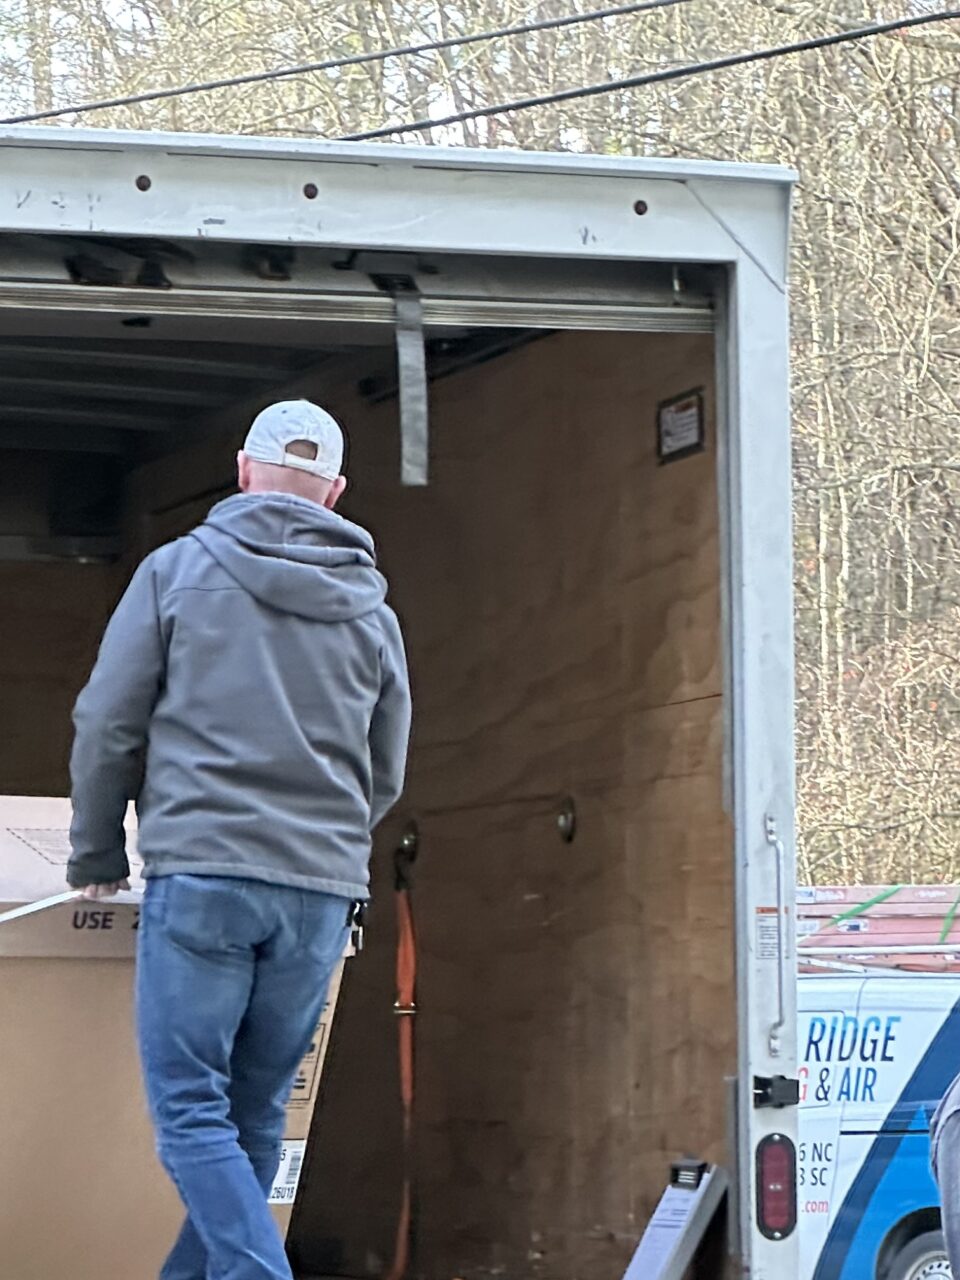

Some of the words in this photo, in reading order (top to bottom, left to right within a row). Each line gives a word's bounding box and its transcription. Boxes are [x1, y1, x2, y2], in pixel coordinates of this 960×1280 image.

[72, 911, 115, 929] USE
[804, 1016, 901, 1062] RIDGE
[815, 1068, 831, 1101] &
[838, 1068, 877, 1102] AIR
[812, 1142, 832, 1162] NC
[811, 1167, 827, 1186] SC
